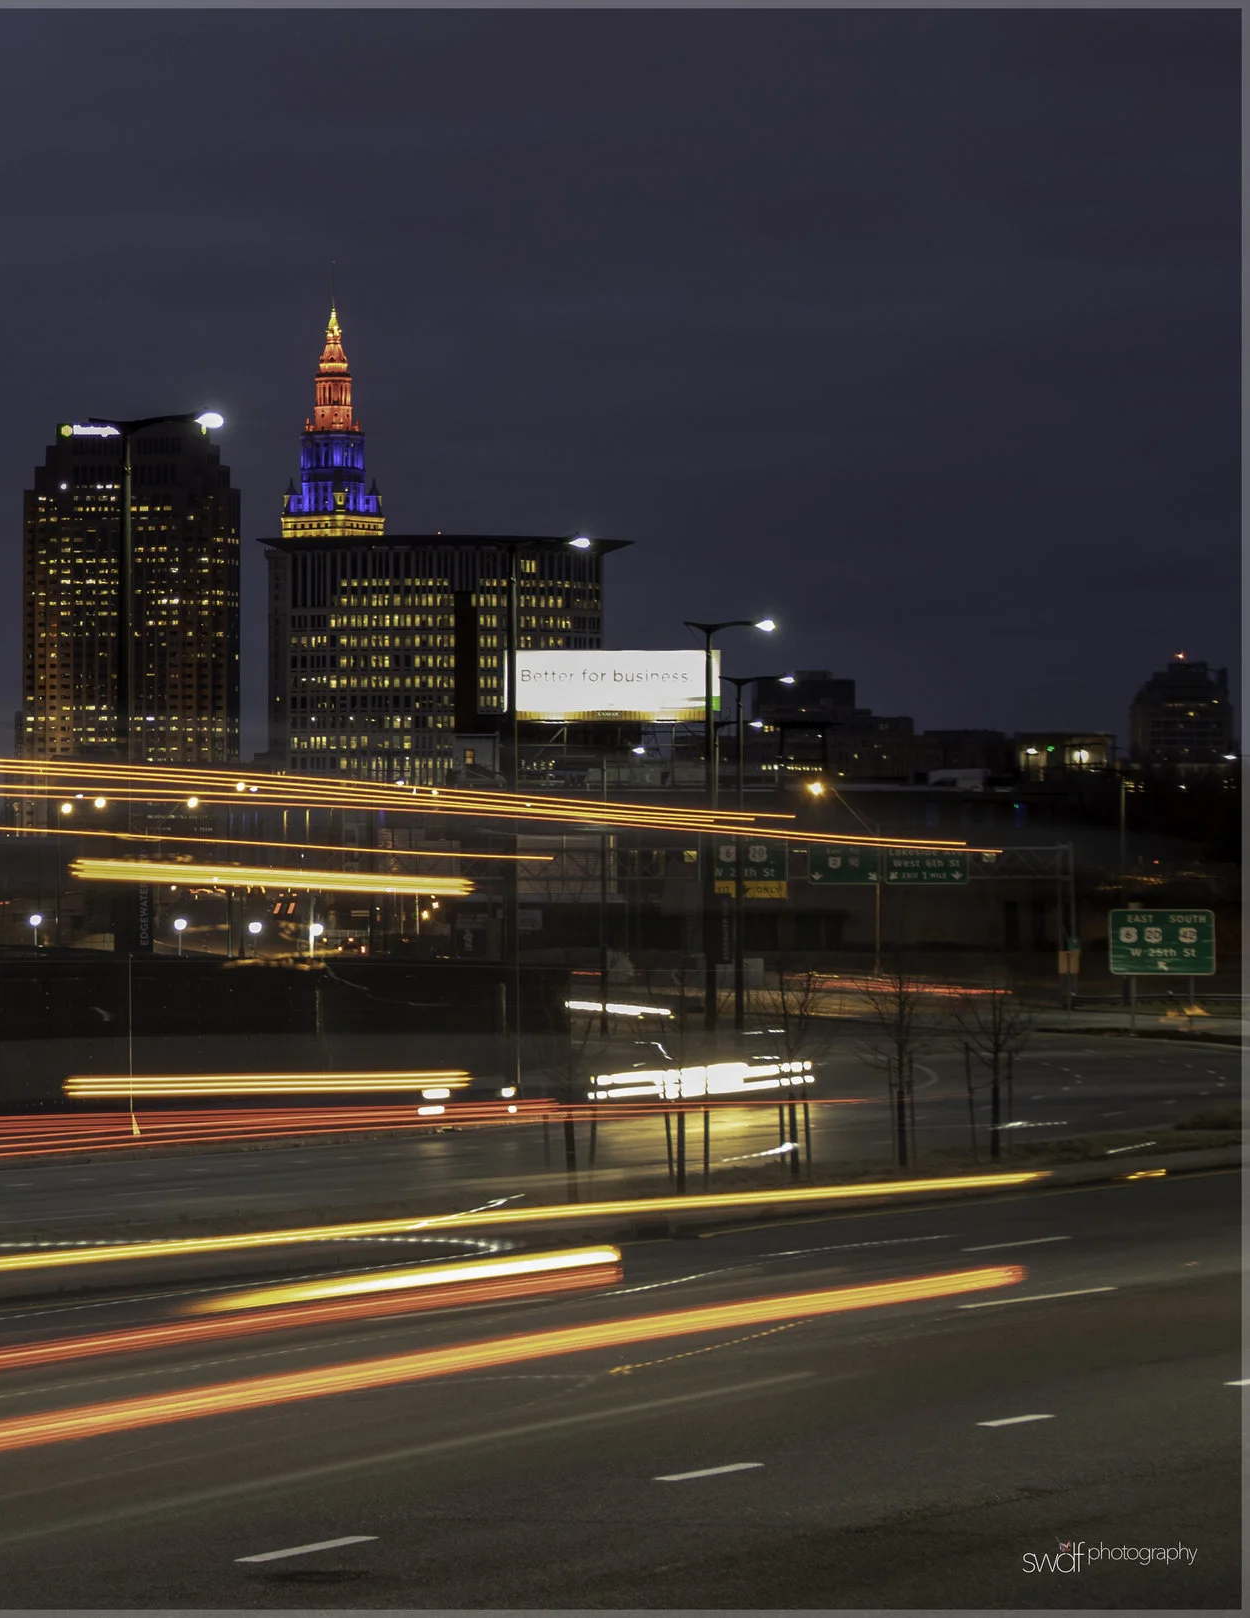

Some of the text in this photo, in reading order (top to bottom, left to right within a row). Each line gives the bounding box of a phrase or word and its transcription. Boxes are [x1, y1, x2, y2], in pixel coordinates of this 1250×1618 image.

[521, 669, 575, 683] Better
[582, 669, 607, 683] for
[725, 848, 765, 858] 6 20
[893, 860, 961, 868] West 6th St
[730, 867, 757, 877] 2th
[763, 867, 775, 877] St
[1127, 914, 1207, 924] EAST SOUTH
[1146, 930, 1161, 940] 20
[1130, 947, 1197, 958] W 25th St
